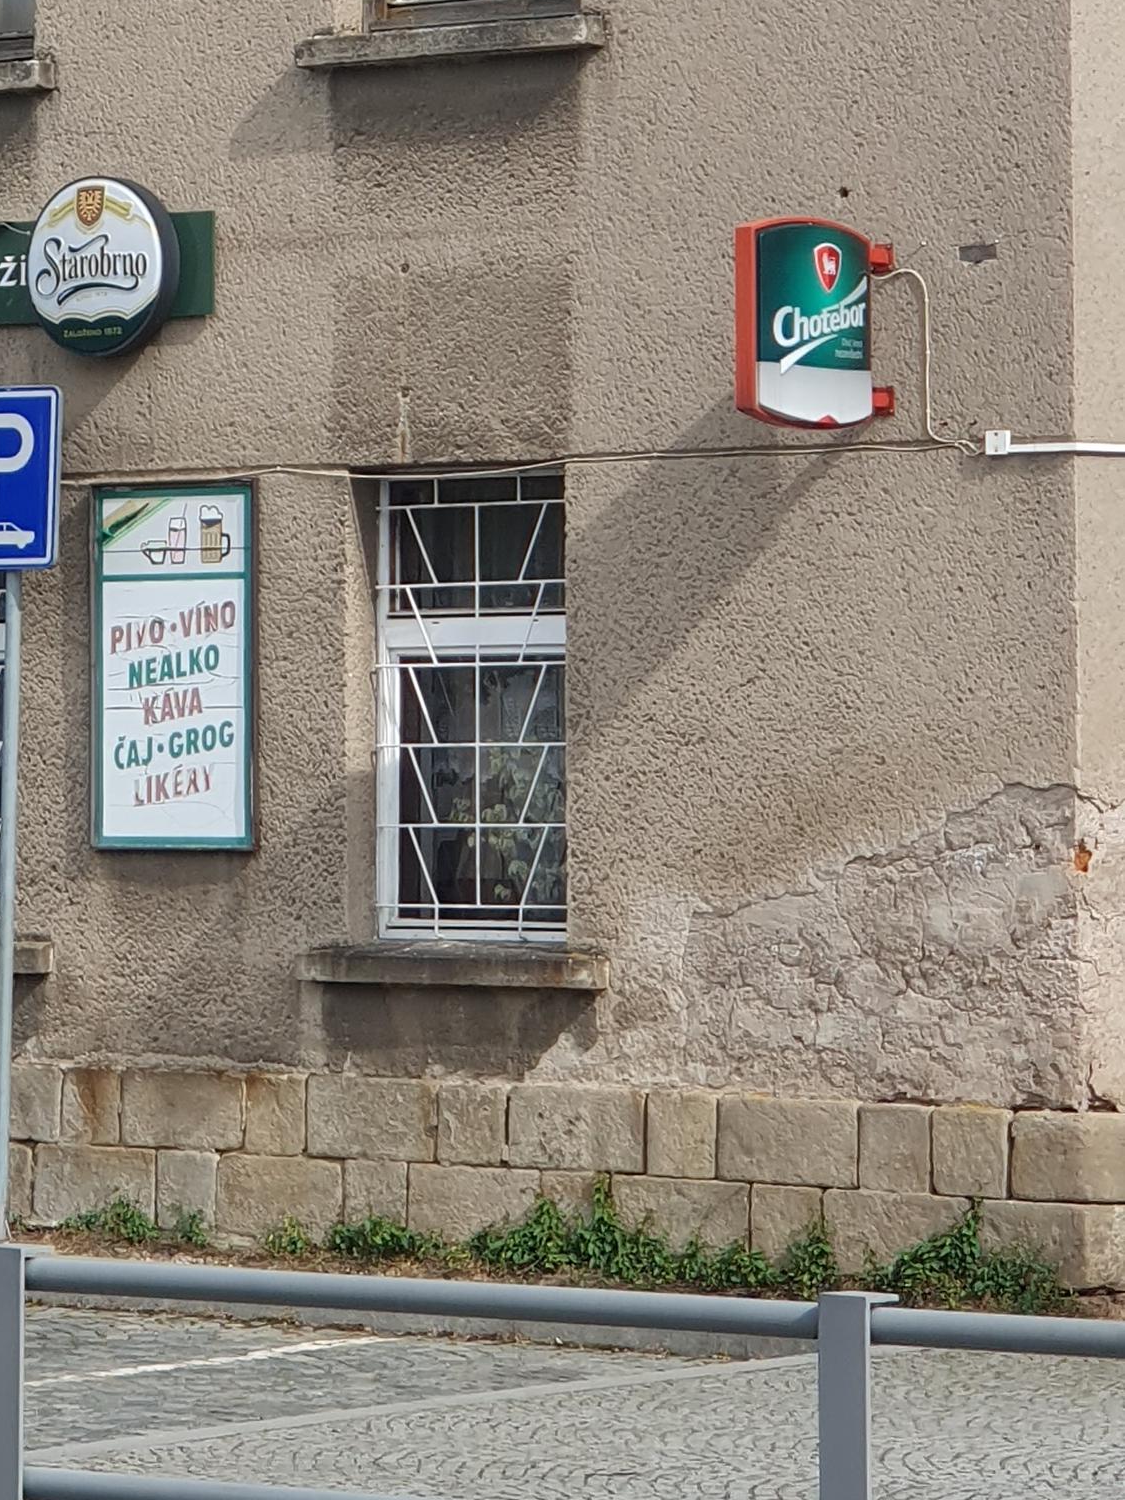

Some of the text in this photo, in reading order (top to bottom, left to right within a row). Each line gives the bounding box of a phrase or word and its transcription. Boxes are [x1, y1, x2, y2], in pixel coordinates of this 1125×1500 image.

[36, 234, 148, 300] Starobrno
[179, 600, 236, 638] VÍNO
[128, 644, 220, 689] NEALKO
[143, 687, 203, 726] KÁVA
[113, 720, 235, 770] ČAJ GROG
[132, 764, 213, 806] LIKÉRY
